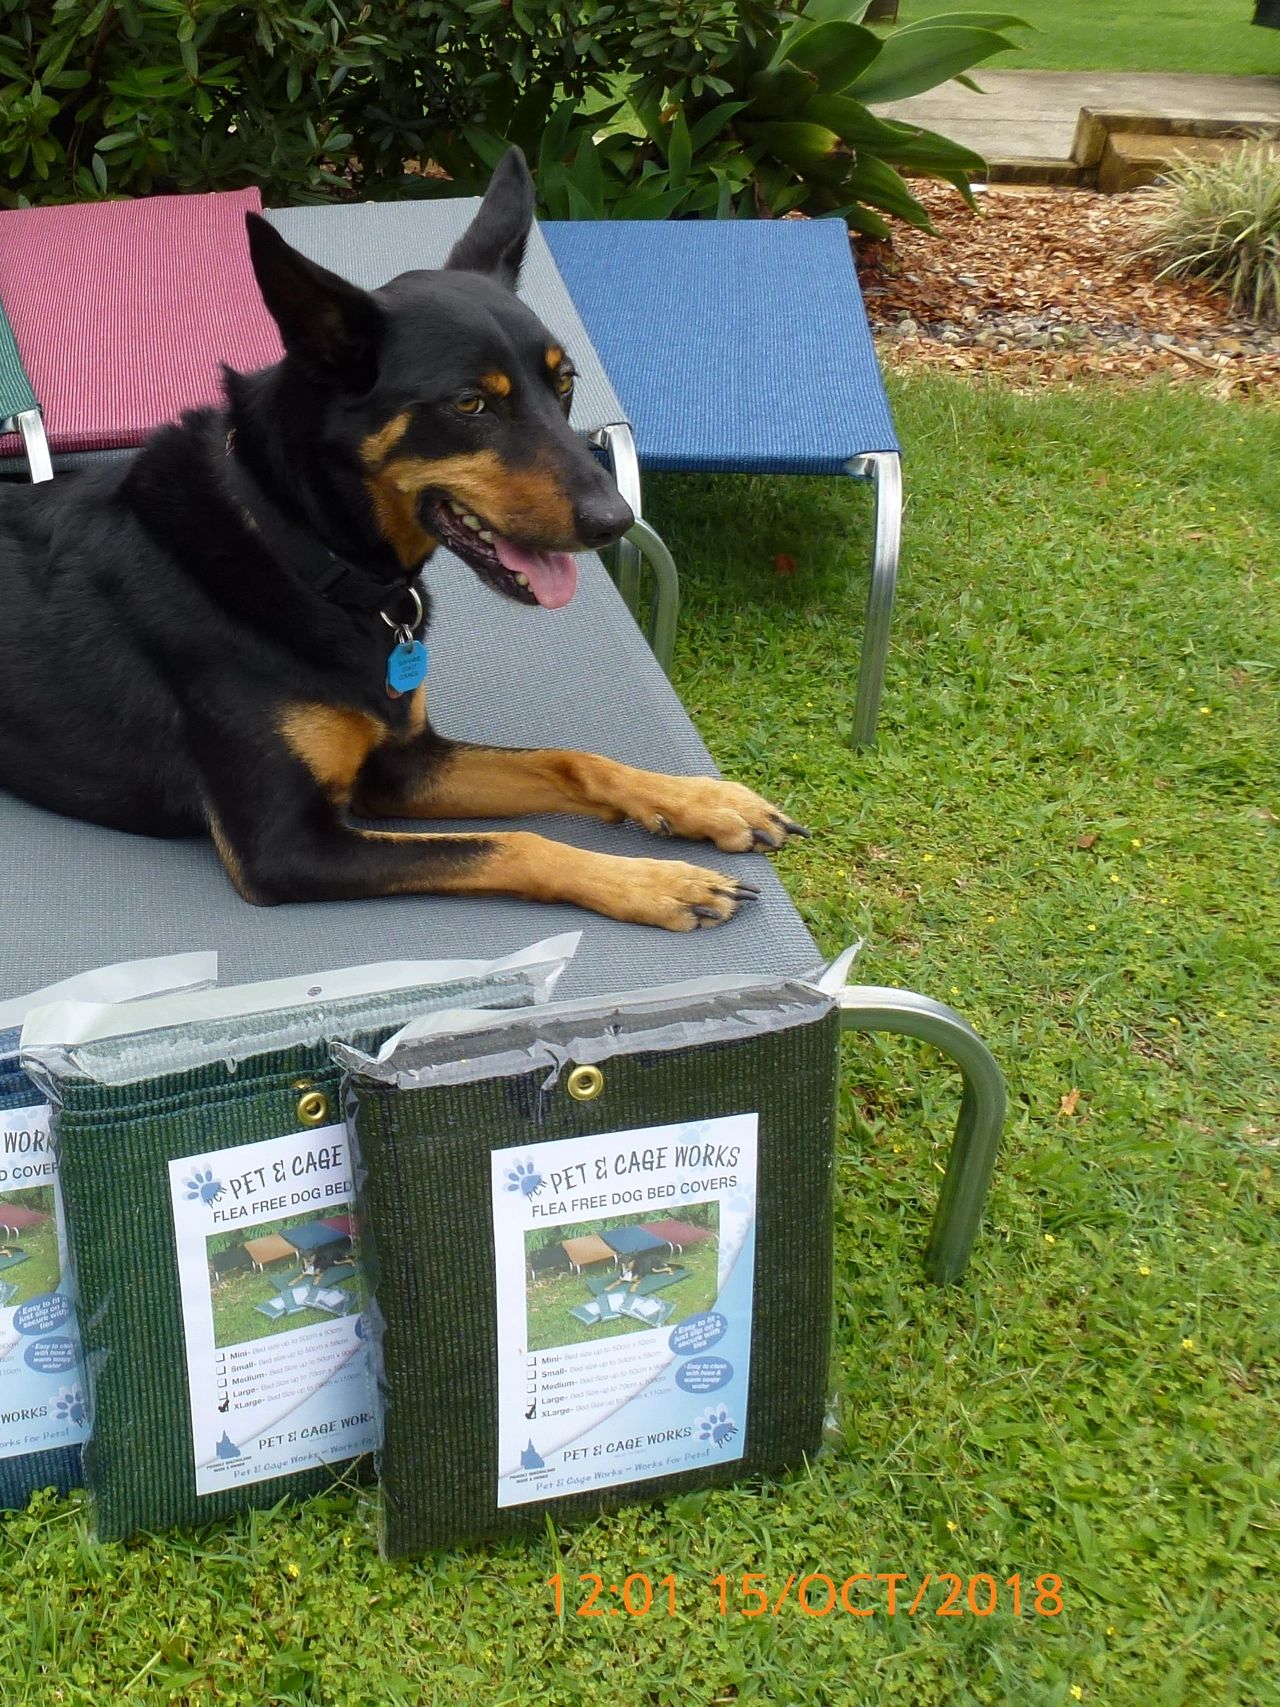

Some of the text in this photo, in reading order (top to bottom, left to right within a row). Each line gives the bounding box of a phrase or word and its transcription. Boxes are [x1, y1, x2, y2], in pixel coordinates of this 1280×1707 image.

[230, 1144, 343, 1199] PET & CAGE
[550, 1144, 740, 1194] PET & CAGE WORKS
[213, 1180, 354, 1223] FLEA FREE DOG BED
[532, 1175, 737, 1218] FLEA FREE DOG BED COVERS
[1, 1406, 47, 1424] WORKS
[259, 1435, 283, 1450] PET
[301, 1420, 337, 1439] CAGE
[341, 1413, 371, 1428] WOR
[564, 1427, 691, 1462] PET & CAGE WORKS
